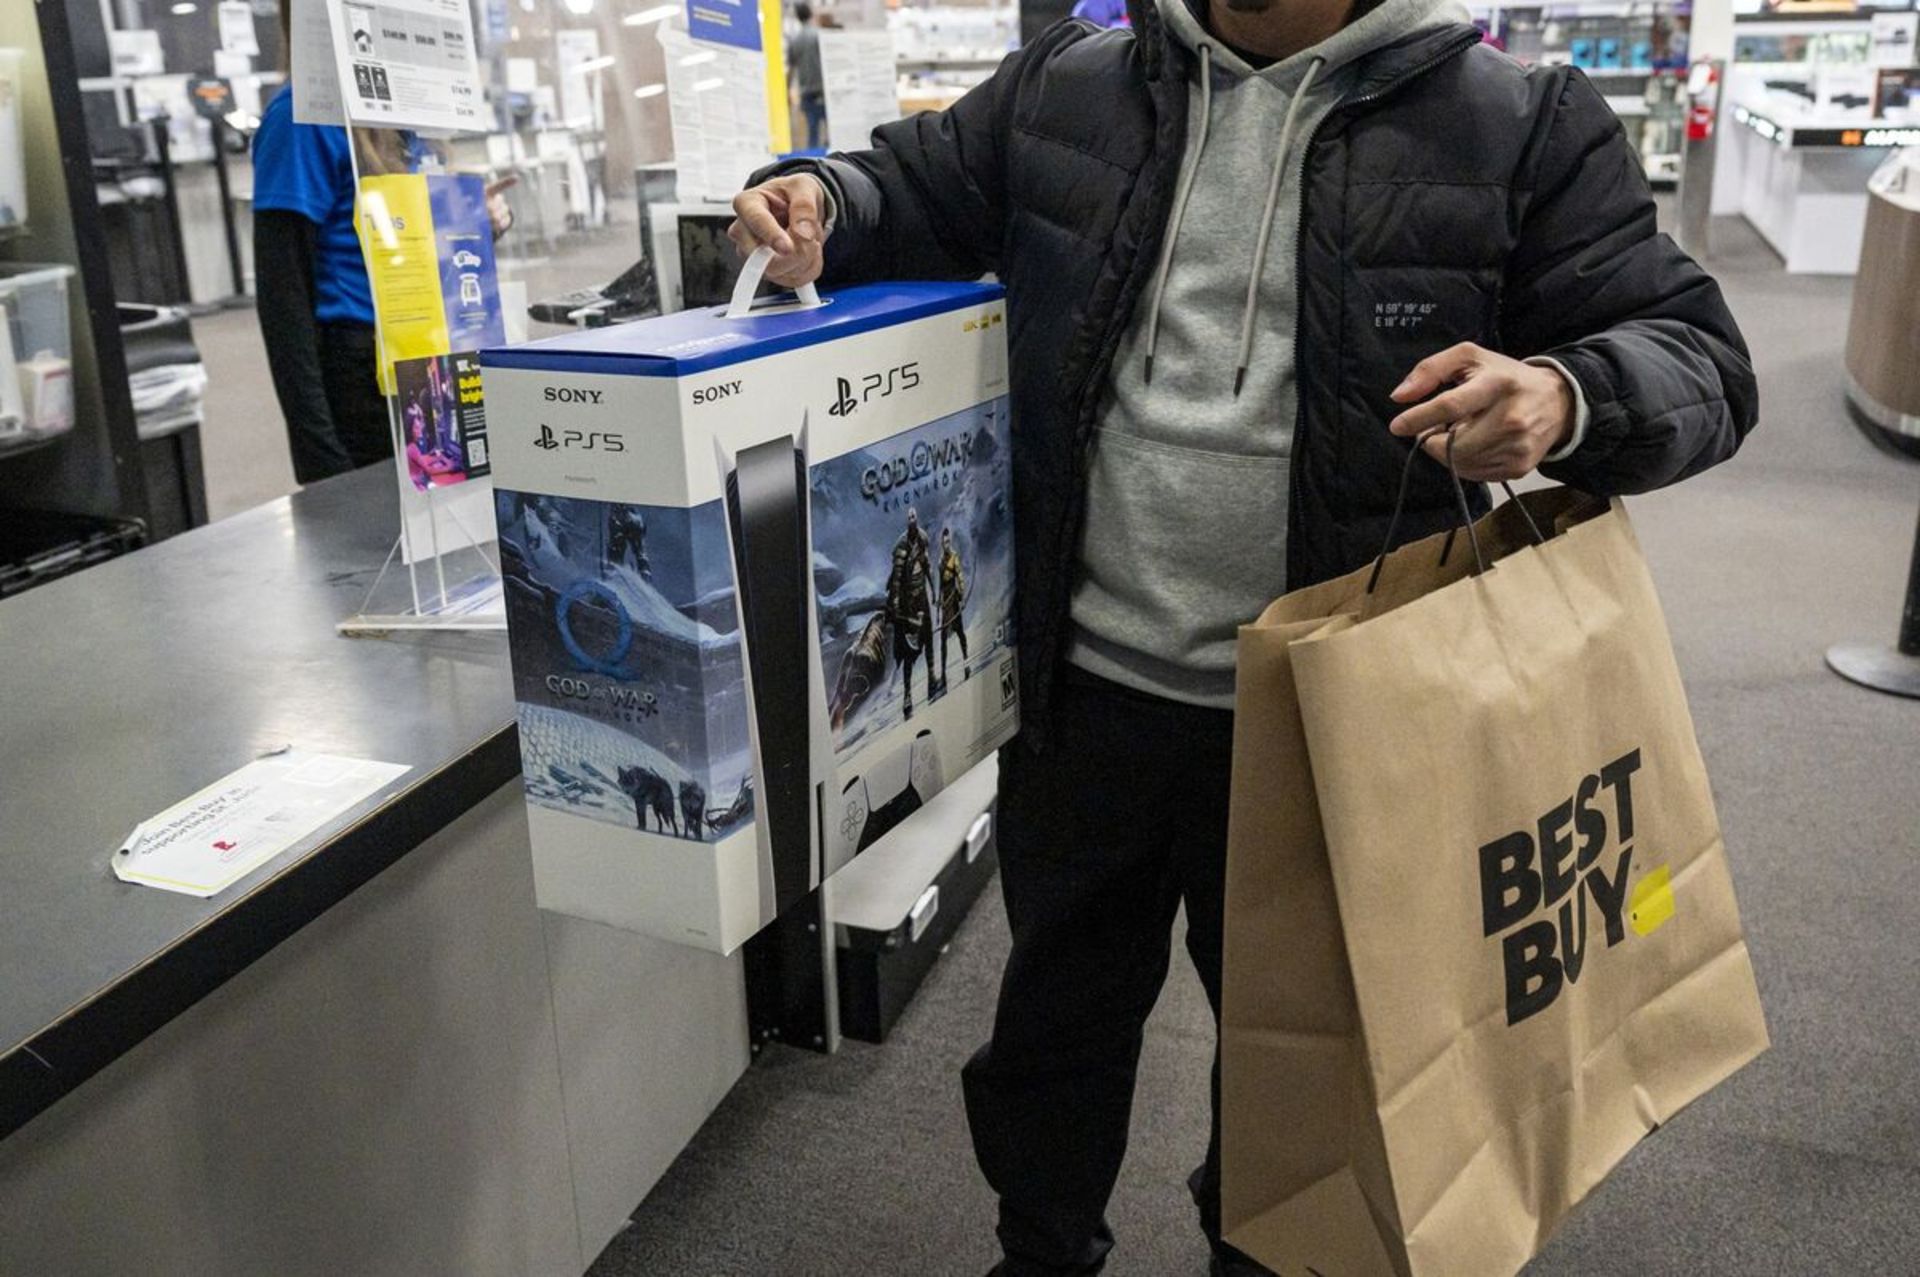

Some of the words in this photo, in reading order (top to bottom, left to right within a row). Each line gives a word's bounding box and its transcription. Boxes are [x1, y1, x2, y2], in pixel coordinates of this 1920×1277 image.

[1375, 303, 1383, 314] N
[1375, 316, 1382, 327] E
[544, 387, 602, 404] SONY
[692, 380, 742, 405] SONY
[863, 362, 919, 402] PS5
[564, 430, 624, 452] PS5
[861, 457, 910, 506] GOD
[927, 432, 974, 470] WAR
[546, 674, 590, 700] GOD
[608, 686, 659, 718] WAR
[1001, 671, 1015, 700] M
[1479, 747, 1641, 938] BEST
[1502, 845, 1634, 1027] BUY
